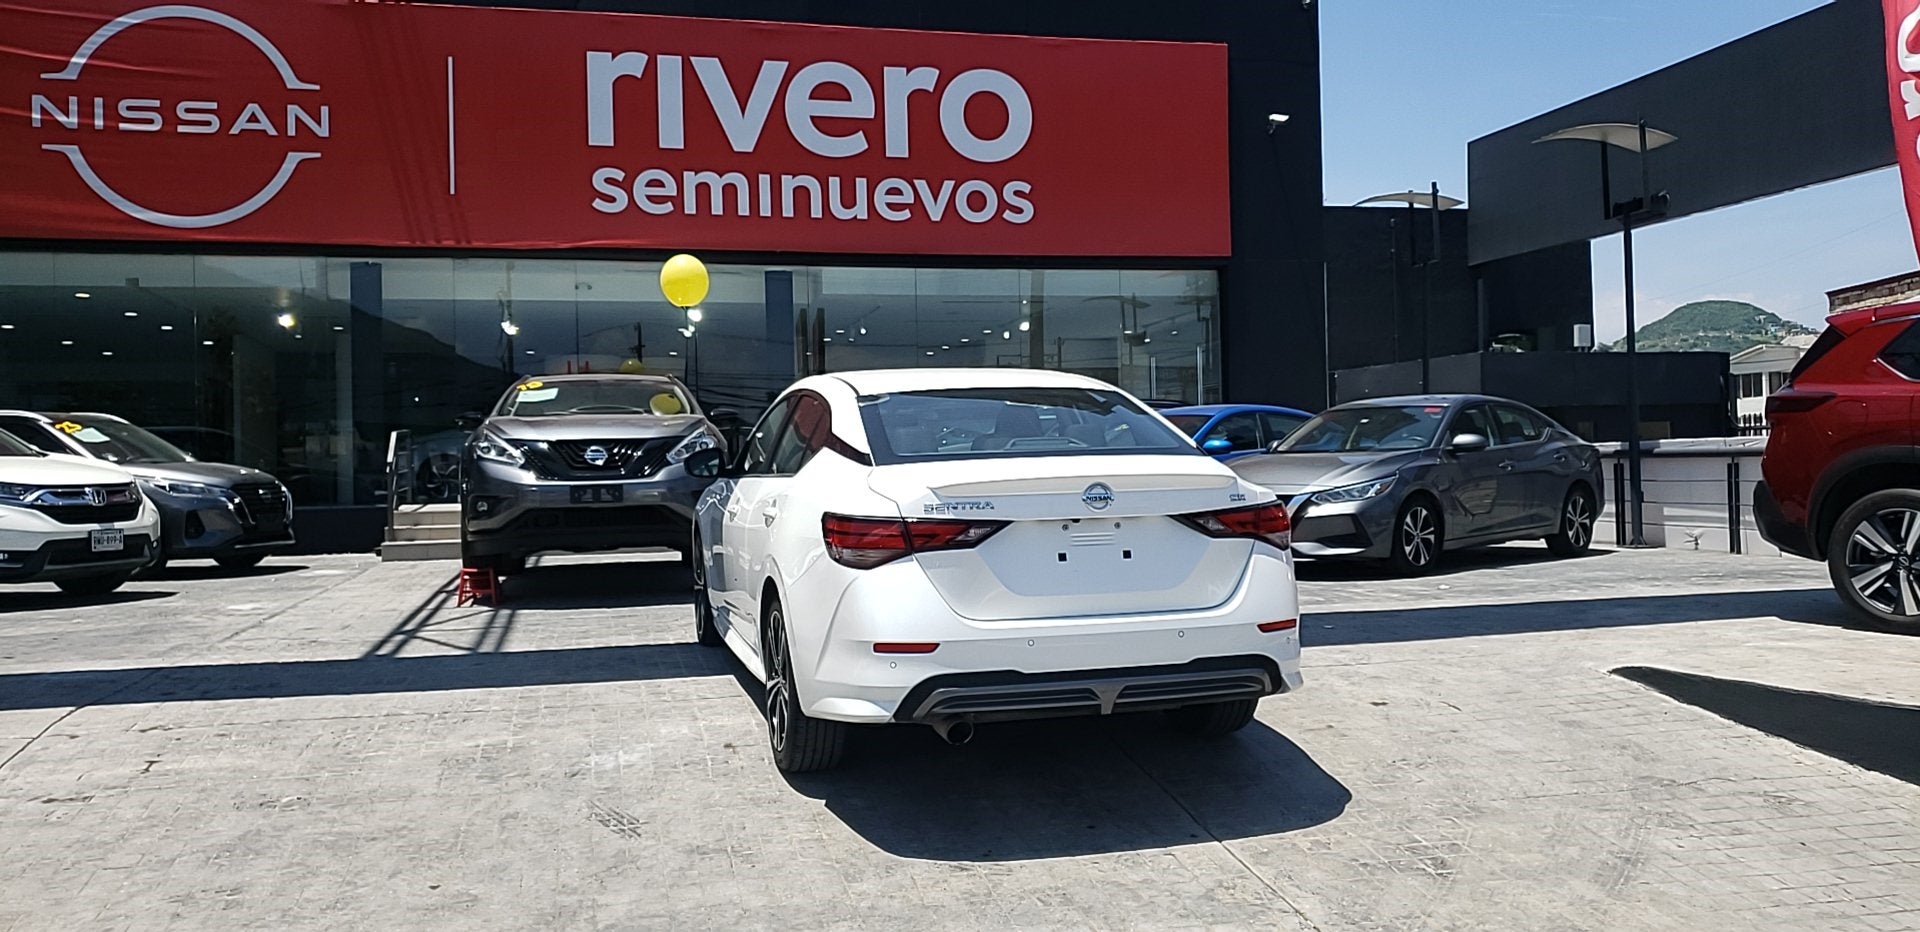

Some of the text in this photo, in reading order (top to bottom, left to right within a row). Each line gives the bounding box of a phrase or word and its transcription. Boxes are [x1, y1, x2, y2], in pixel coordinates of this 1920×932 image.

[31, 94, 330, 137] NISSAN
[586, 51, 1033, 163] rivero
[591, 167, 1034, 224] seminuevos
[923, 501, 995, 515] SENTRA
